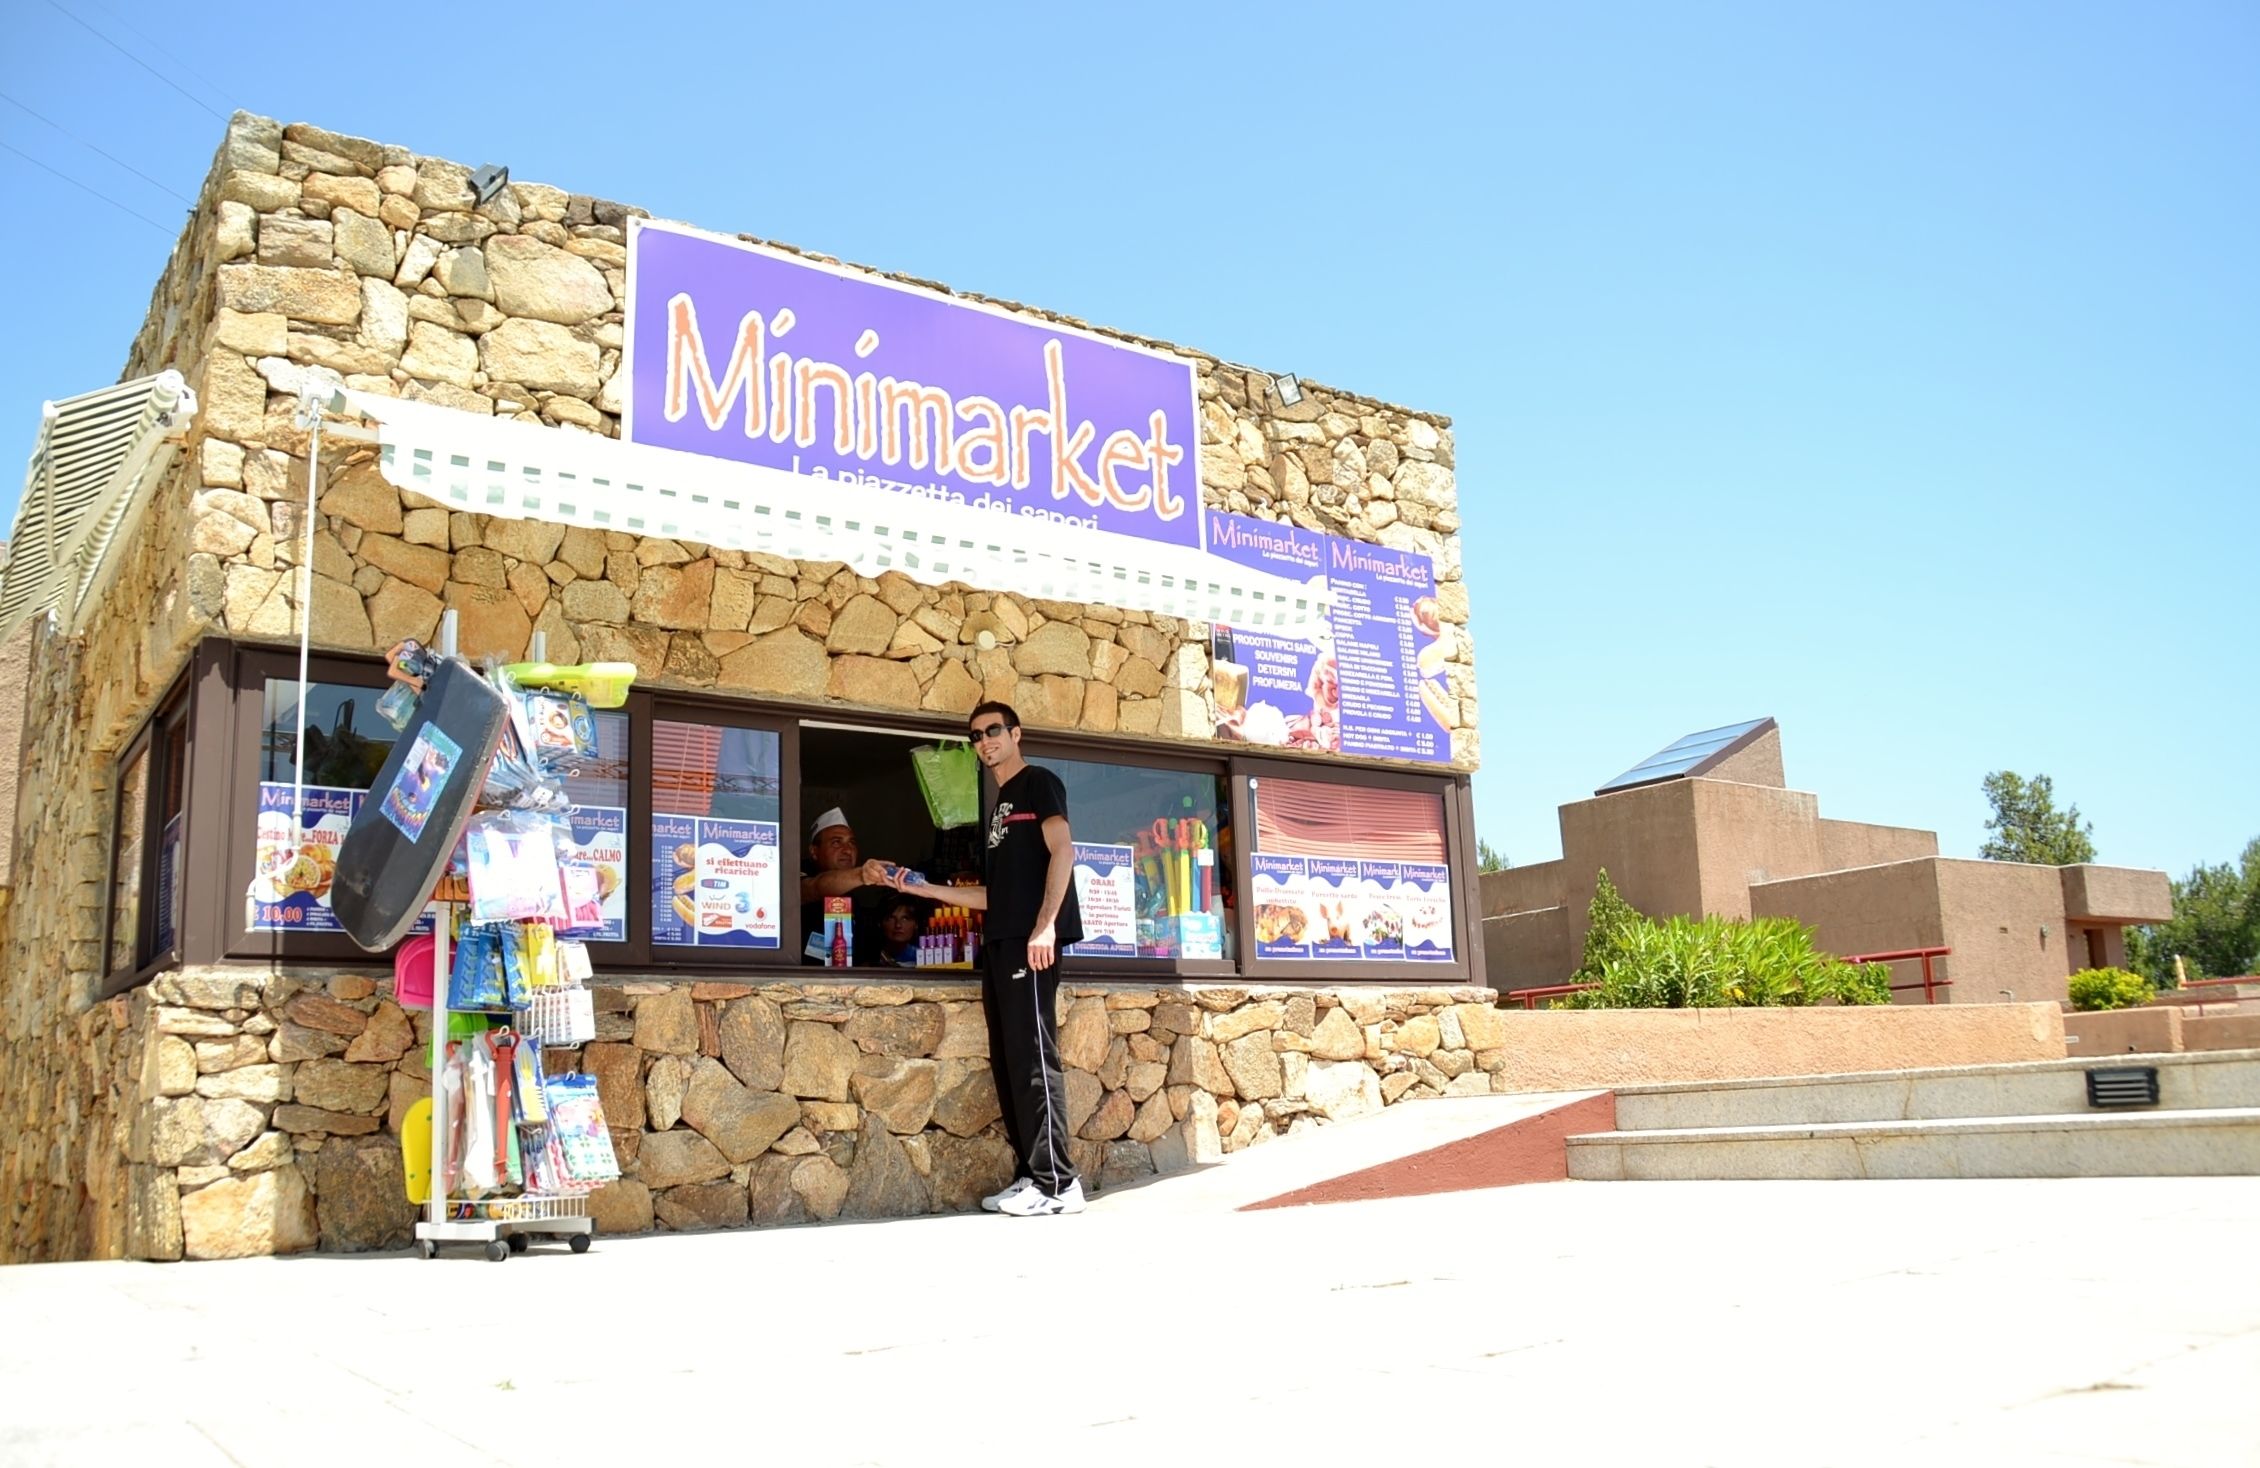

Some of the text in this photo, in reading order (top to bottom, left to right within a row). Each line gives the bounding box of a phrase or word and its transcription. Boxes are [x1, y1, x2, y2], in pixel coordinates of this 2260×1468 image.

[664, 293, 1184, 521] Minimarket
[1213, 516, 1318, 560] Minimarket
[1331, 540, 1429, 582] Minimarket
[1232, 633, 1272, 648] PRODOTTI
[1272, 639, 1294, 651] TIPICI
[1254, 650, 1298, 664] SOUVENIRS
[1257, 663, 1296, 678] DETERSIVI
[1252, 676, 1302, 692] PROFUMERIA
[703, 822, 774, 841] Minimarket
[1074, 846, 1130, 862] Minimarket
[718, 858, 768, 868] effettuano
[1255, 857, 1303, 871] Minimarket
[1310, 860, 1357, 874] Minimarket
[1363, 863, 1399, 877] Minimark
[715, 866, 759, 876] ricariche
[1403, 866, 1445, 879] Minimarket
[701, 902, 731, 910] WIND
